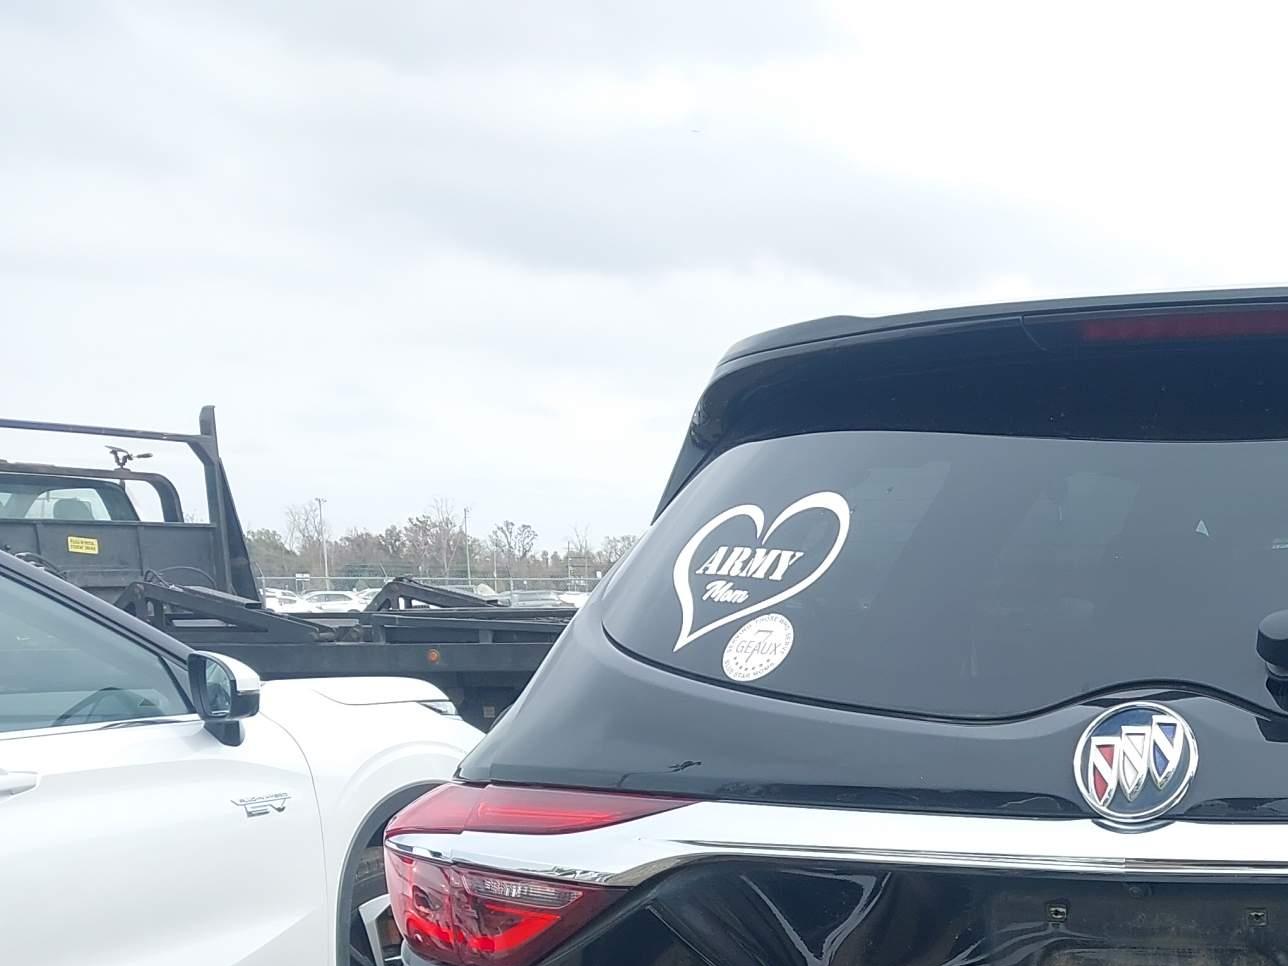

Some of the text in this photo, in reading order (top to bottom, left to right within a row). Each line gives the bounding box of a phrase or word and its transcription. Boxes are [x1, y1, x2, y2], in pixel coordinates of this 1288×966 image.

[696, 546, 804, 581] ARMY
[702, 580, 749, 603] Mom
[735, 640, 782, 655] GEAUX
[243, 800, 287, 818] EV
